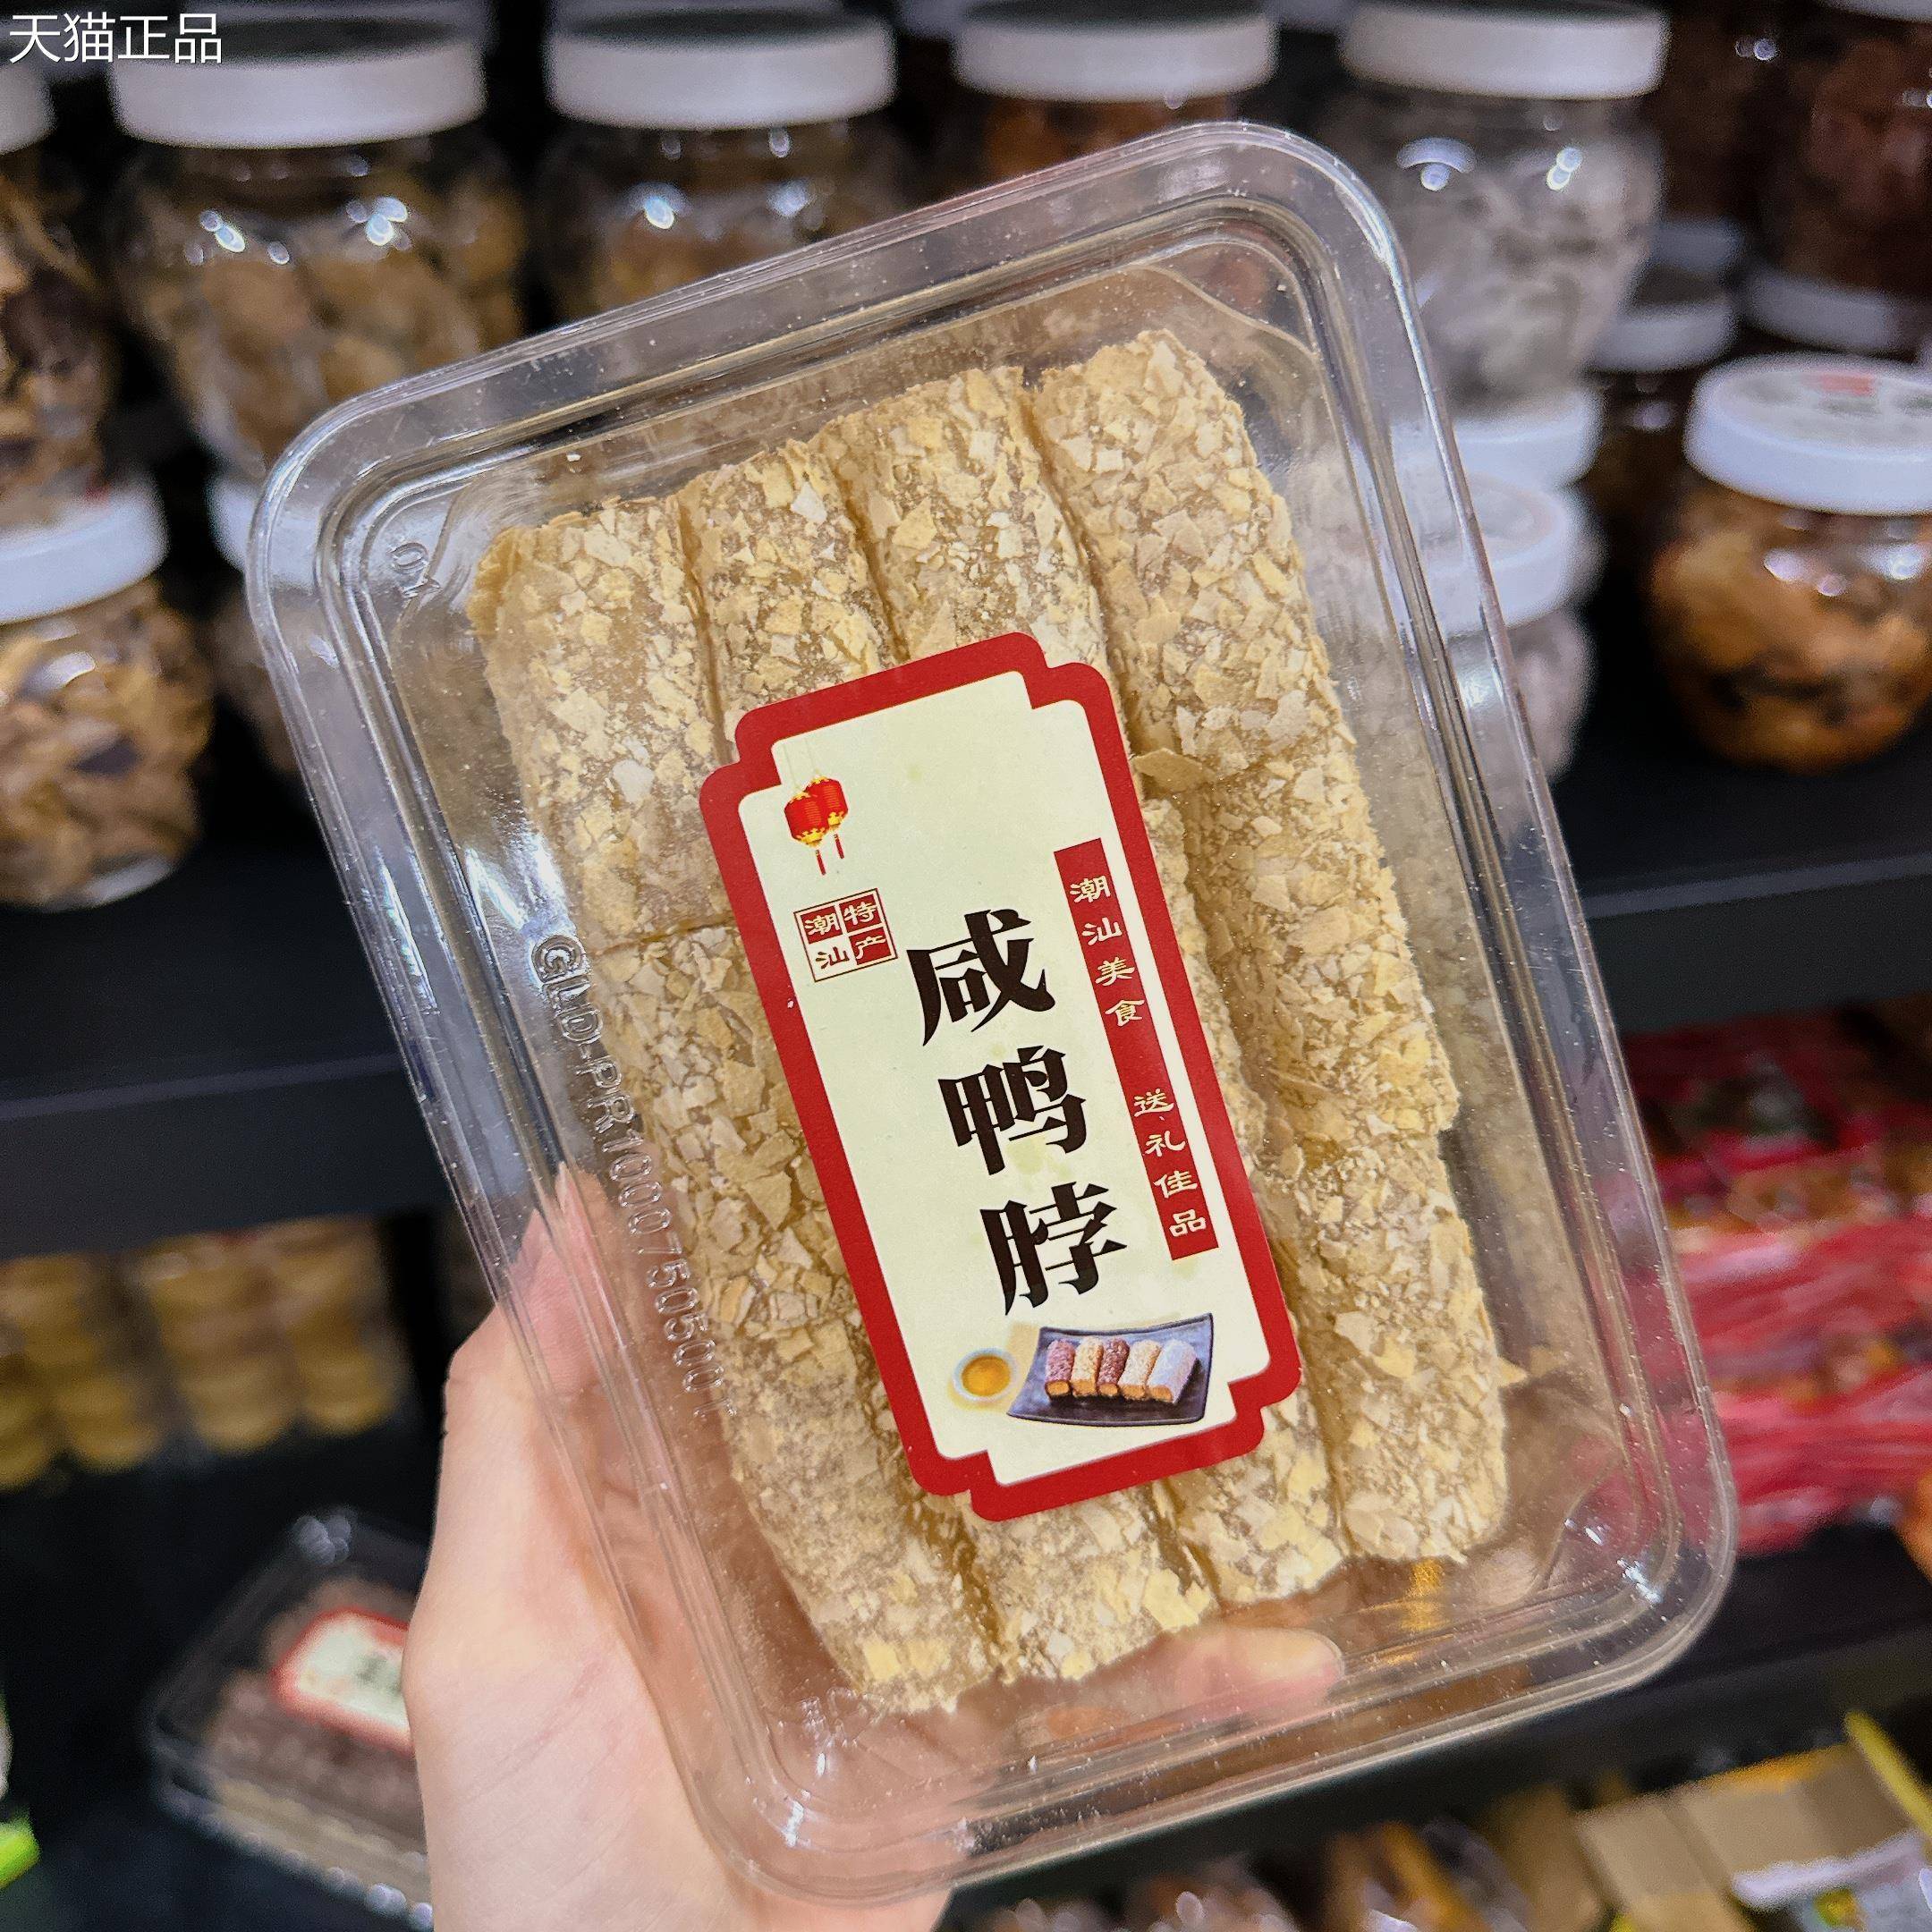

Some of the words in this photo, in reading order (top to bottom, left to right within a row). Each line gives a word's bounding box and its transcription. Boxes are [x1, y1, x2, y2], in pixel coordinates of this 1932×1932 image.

[906, 909, 1128, 1315] 咸鸭脖
[1069, 874, 1145, 1027] 潮汕美食
[1132, 1088, 1207, 1238] 送礼佳品
